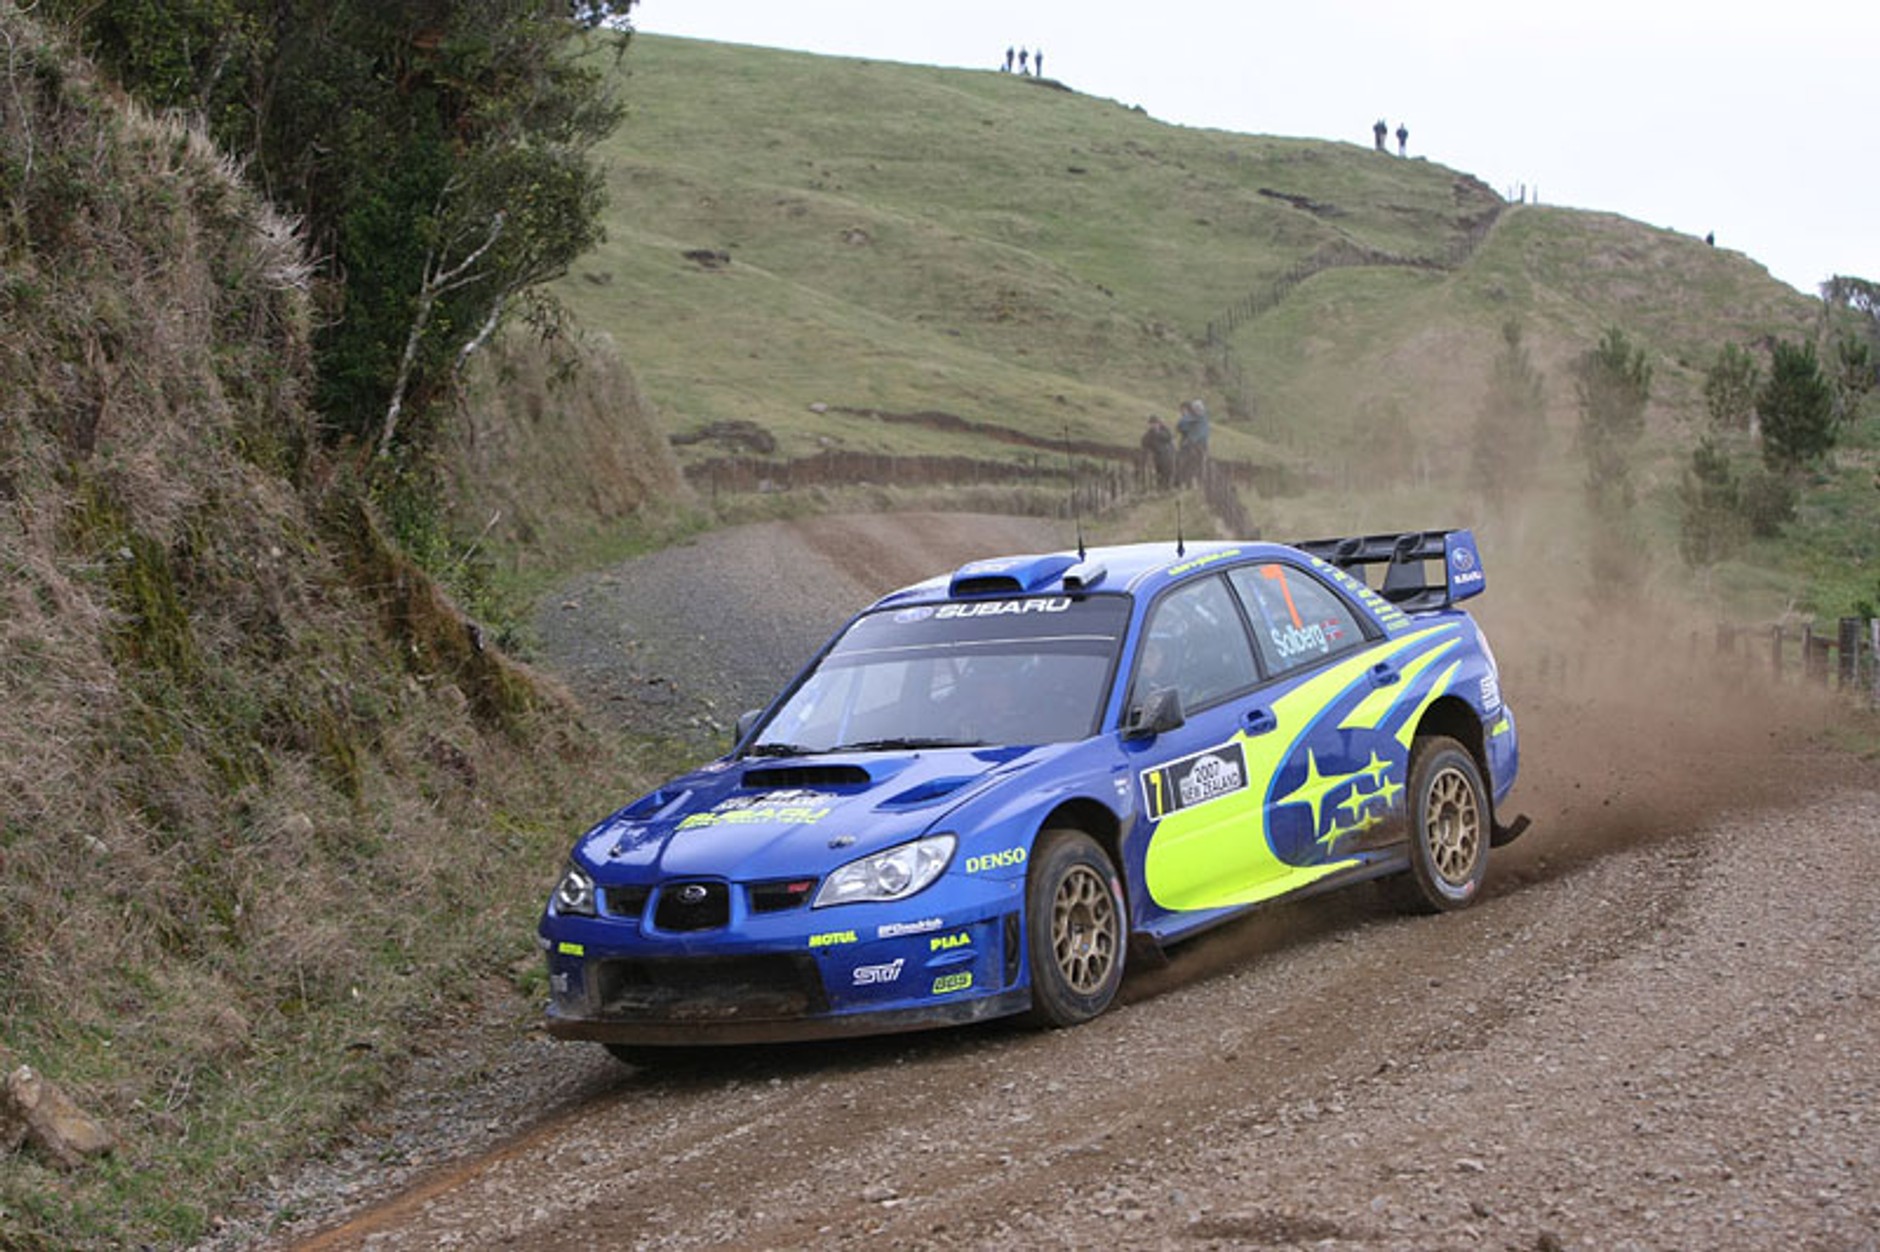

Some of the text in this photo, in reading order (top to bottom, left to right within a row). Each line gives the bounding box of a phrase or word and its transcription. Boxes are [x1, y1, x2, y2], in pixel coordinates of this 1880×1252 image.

[935, 597, 1073, 619] SUBARU
[1259, 564, 1303, 631] 7
[1271, 623, 1330, 658] Solberg
[1194, 760, 1220, 784] 2007
[1203, 772, 1240, 797] ZEALAND
[965, 846, 1027, 874] DENSO
[808, 930, 858, 948] MOTUL
[930, 932, 971, 952] PIAA
